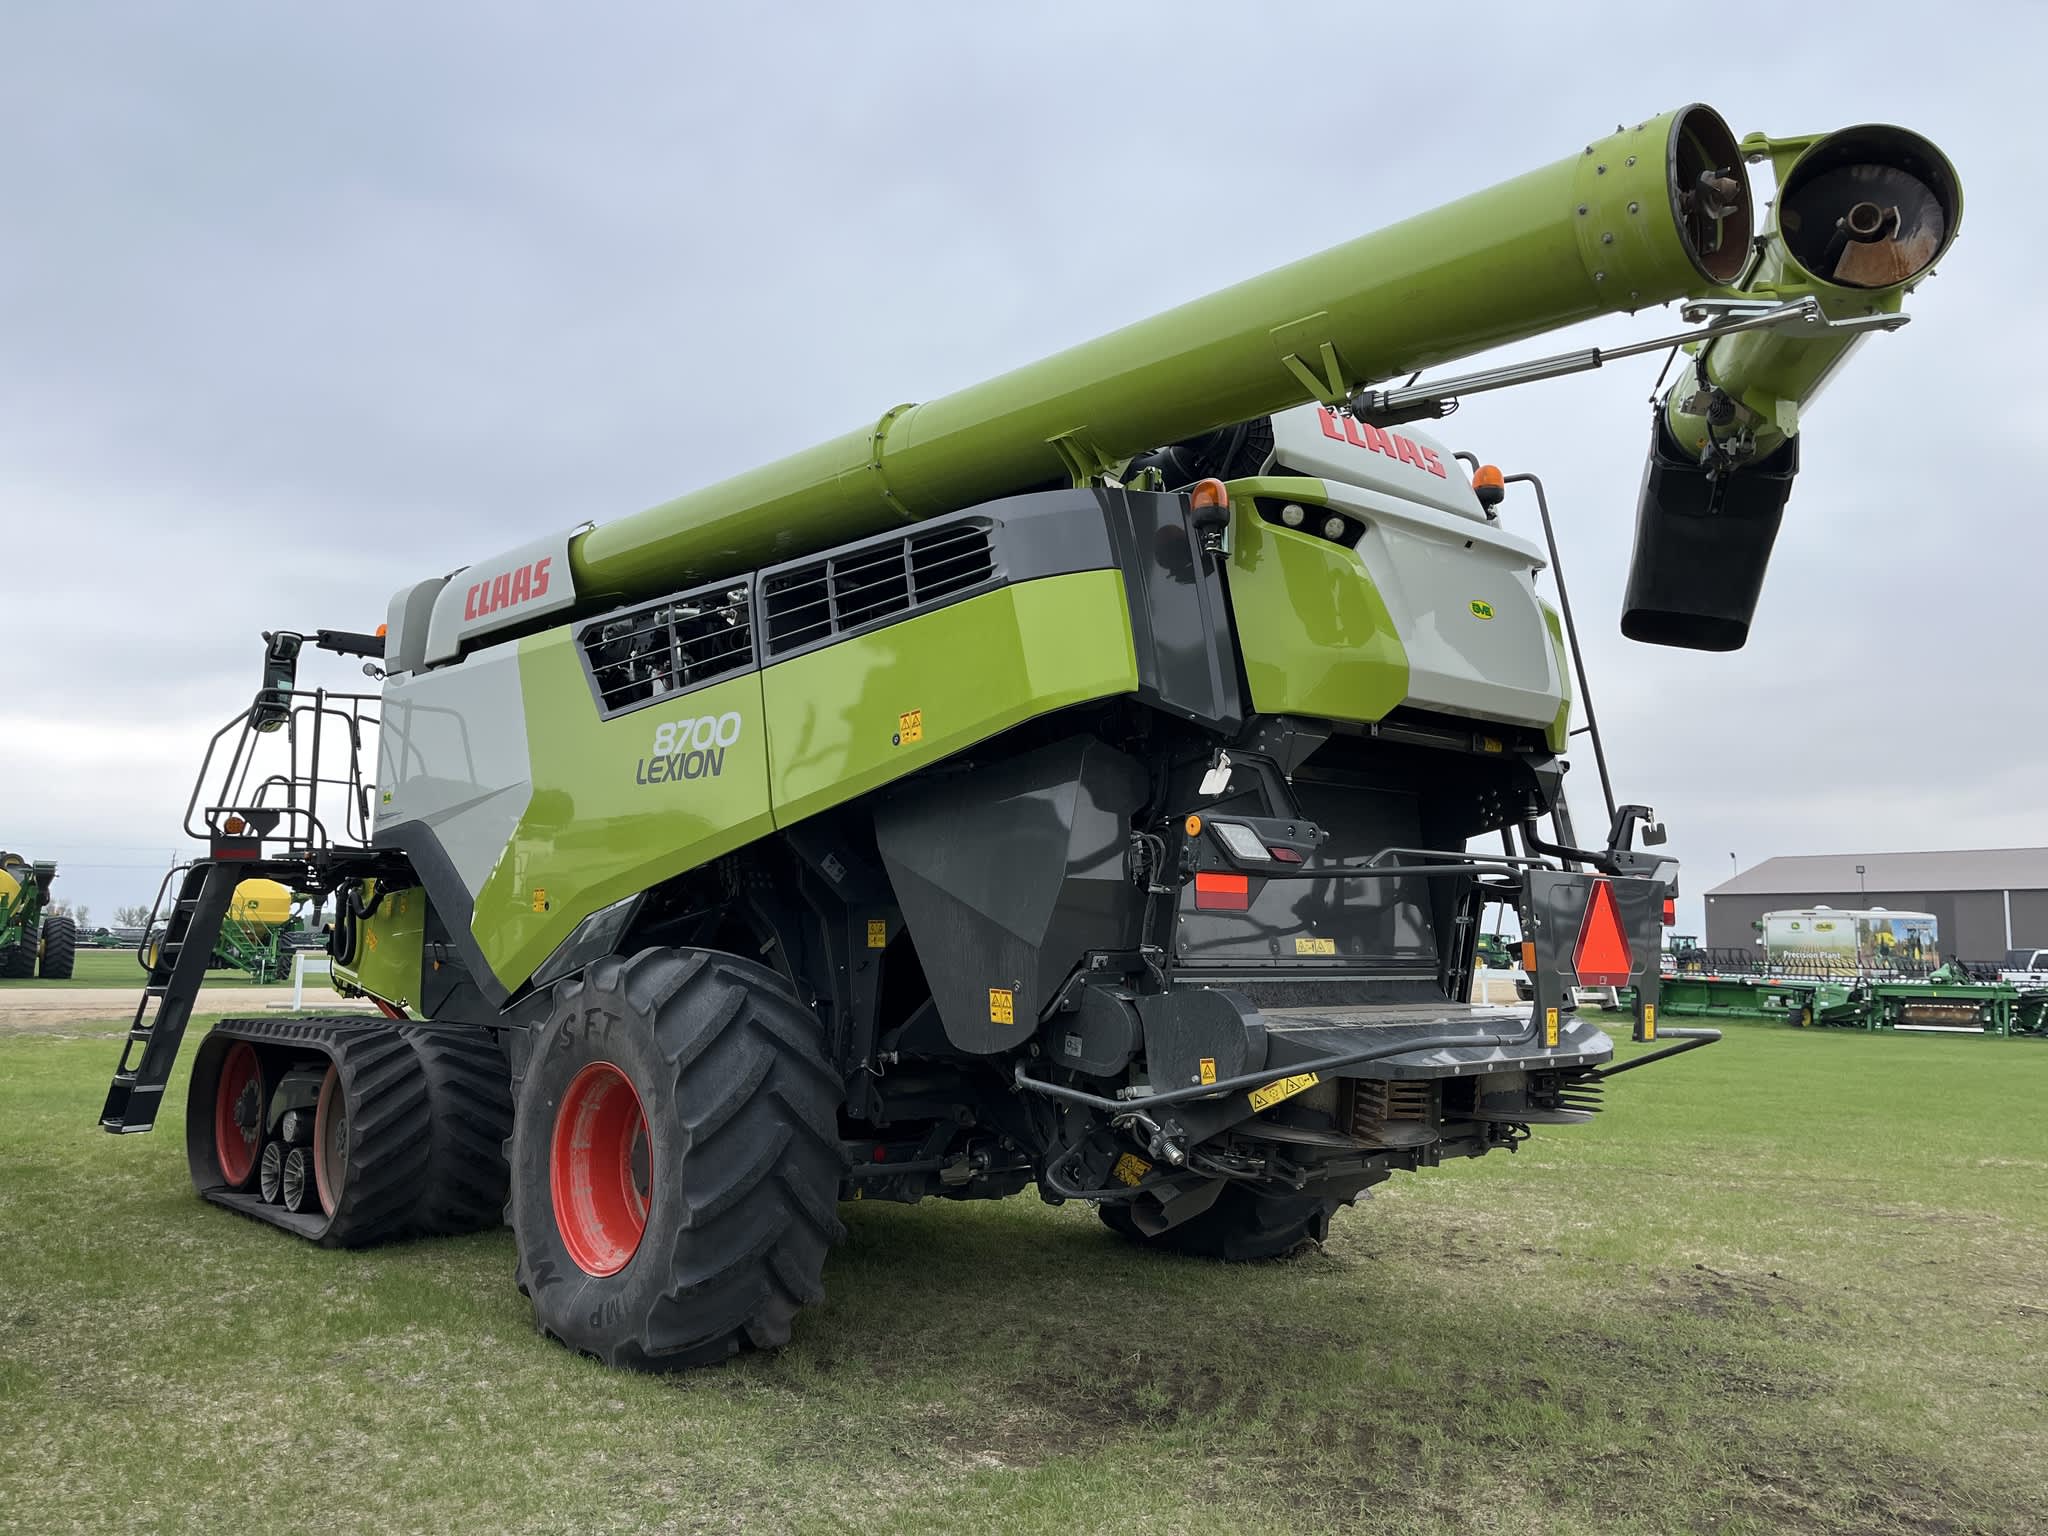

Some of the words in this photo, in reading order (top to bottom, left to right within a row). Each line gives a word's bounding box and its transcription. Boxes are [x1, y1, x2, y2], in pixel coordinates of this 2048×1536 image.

[1317, 406, 1447, 479] CLAAS
[463, 556, 553, 621] CLAAS
[652, 711, 742, 757] 8700
[635, 747, 727, 785] LEXION
[1783, 950, 1818, 959] Precision
[560, 1007, 622, 1049] SFT
